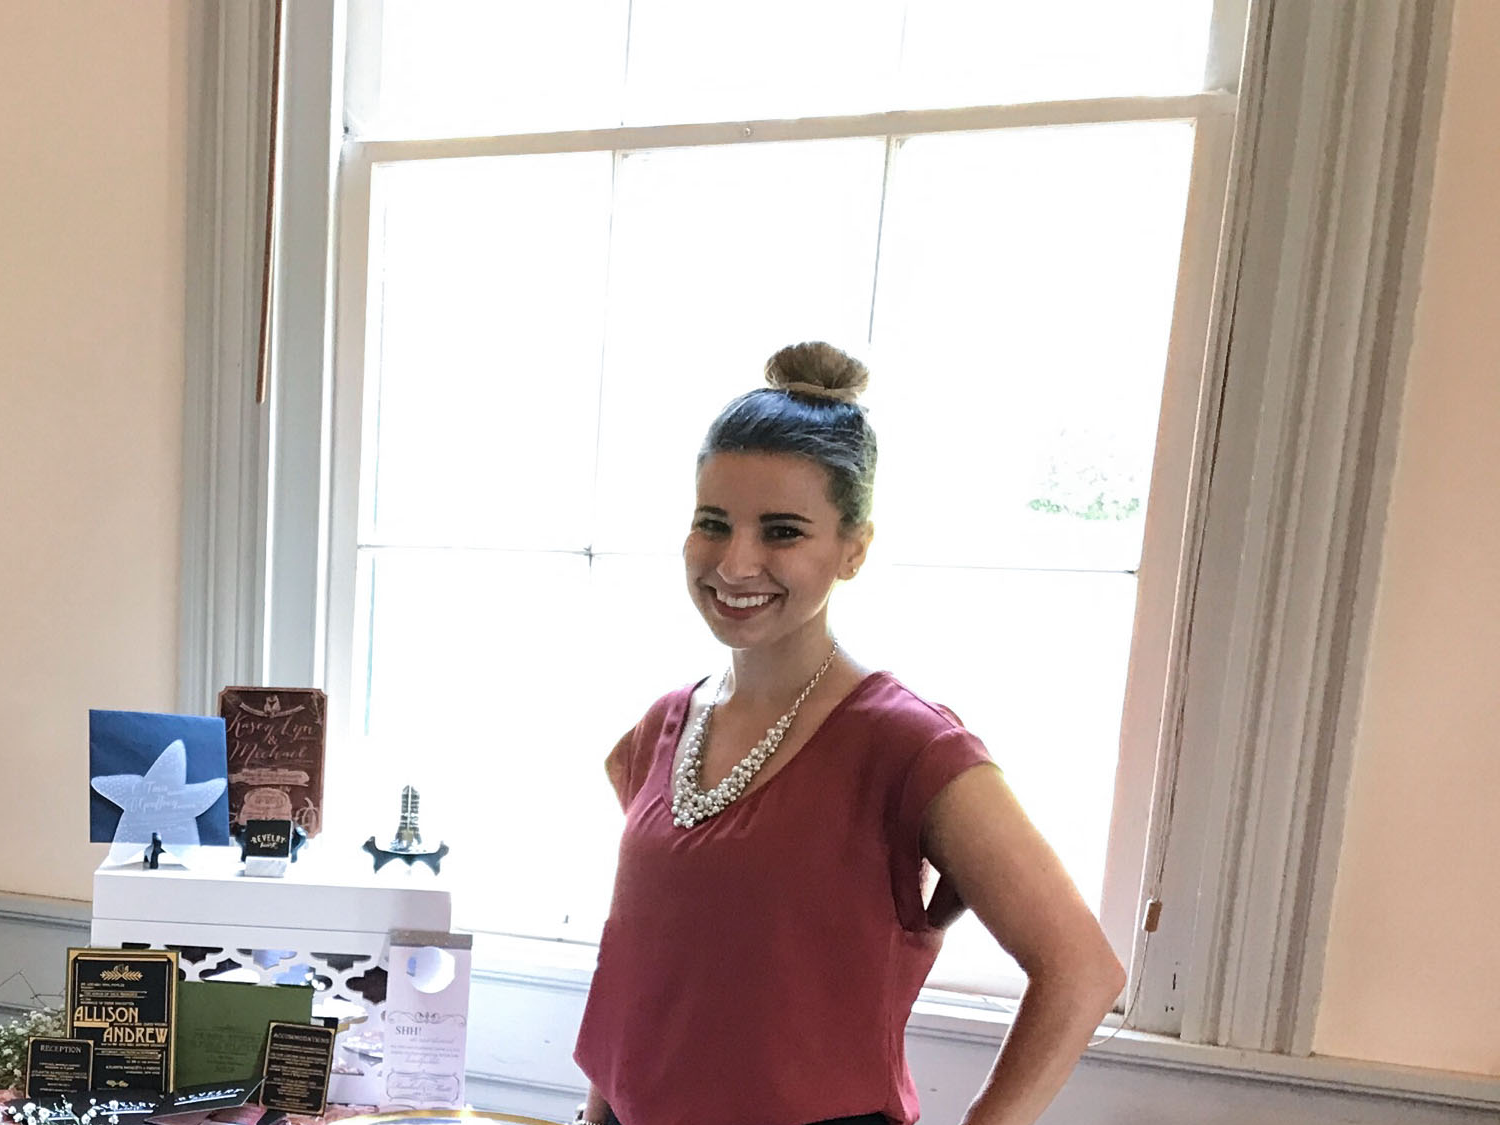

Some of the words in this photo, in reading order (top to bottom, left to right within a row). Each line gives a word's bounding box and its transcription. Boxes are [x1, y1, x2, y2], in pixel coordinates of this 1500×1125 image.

[74, 1006, 139, 1023] ALLISON
[103, 1027, 168, 1043] ANDREW
[40, 1044, 82, 1054] RECEPTION
